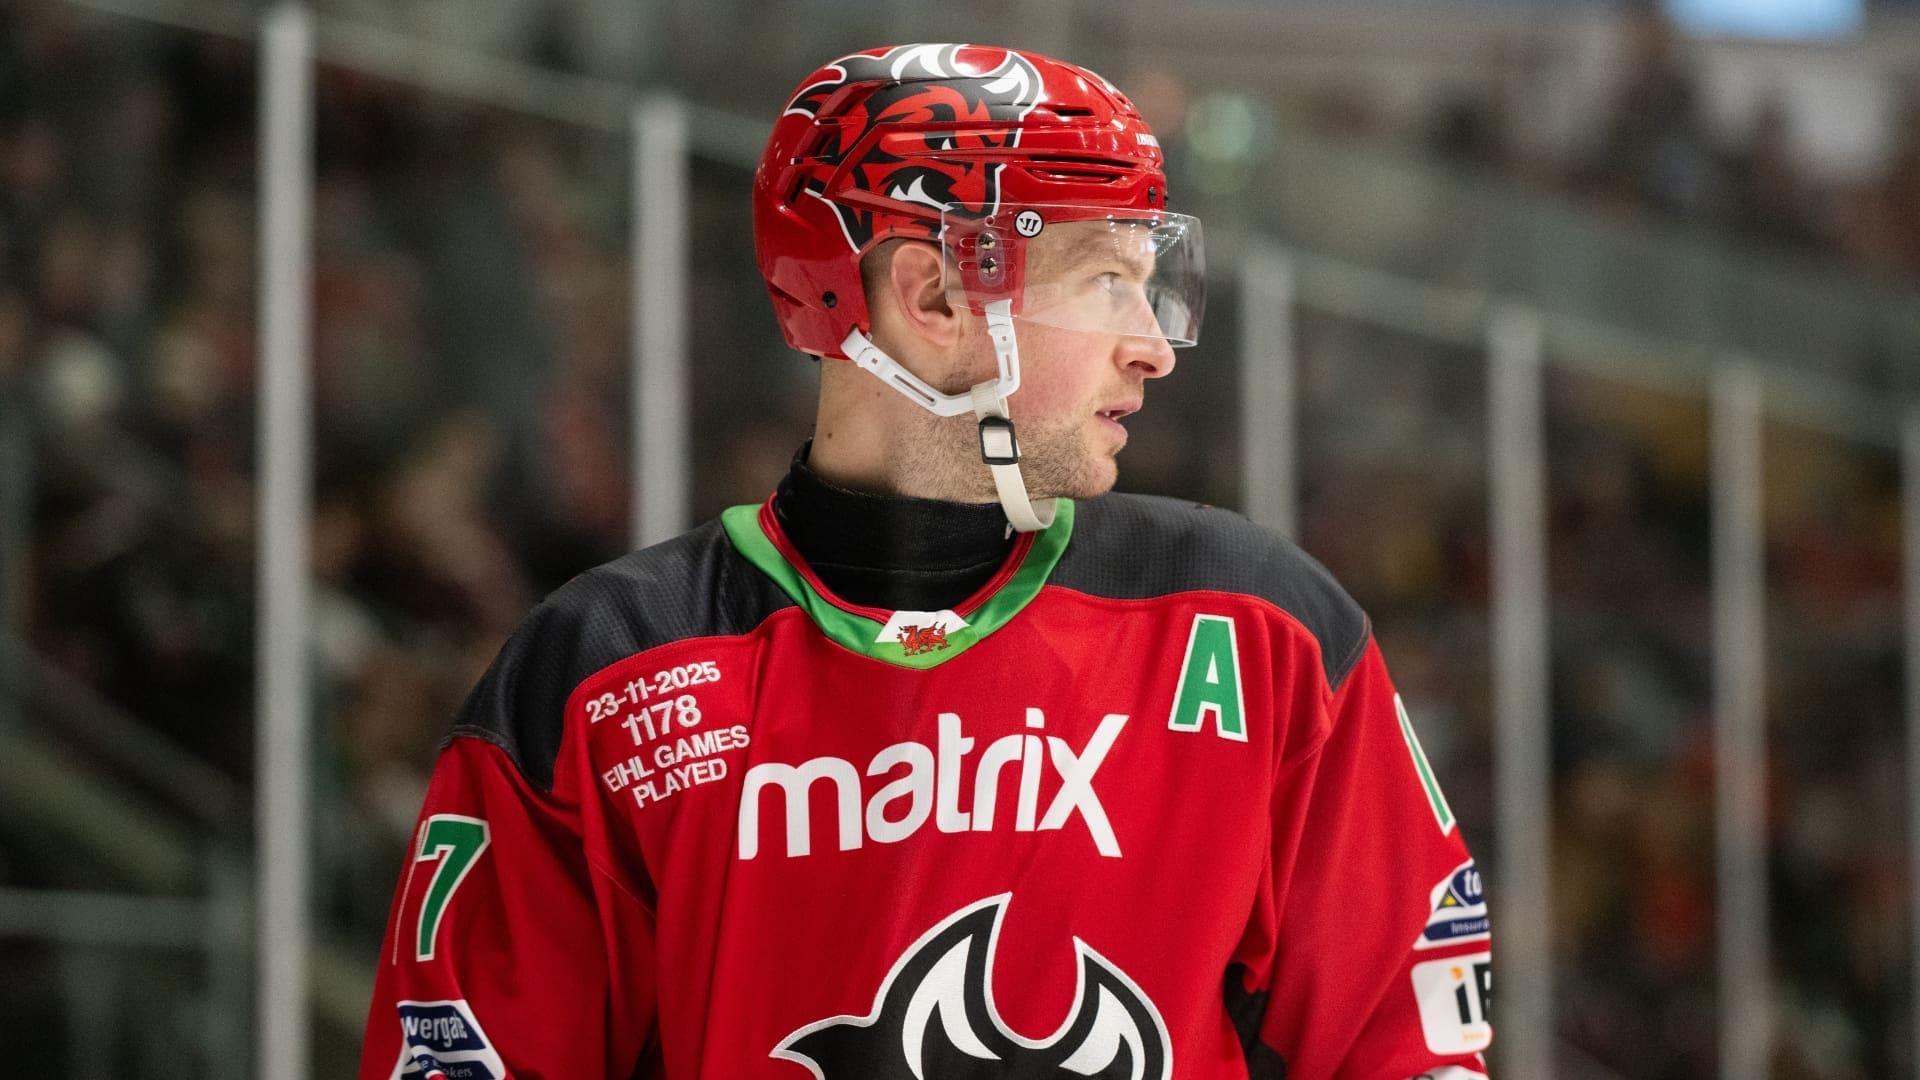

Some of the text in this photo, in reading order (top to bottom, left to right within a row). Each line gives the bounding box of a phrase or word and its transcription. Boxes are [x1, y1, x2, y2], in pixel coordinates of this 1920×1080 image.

[585, 661, 722, 723] 23-11-2025
[1167, 613, 1249, 743] A
[621, 694, 702, 746] 1178
[602, 725, 751, 793] EIHL GAMES
[632, 758, 728, 809] PLAYED
[392, 813, 493, 966] 7
